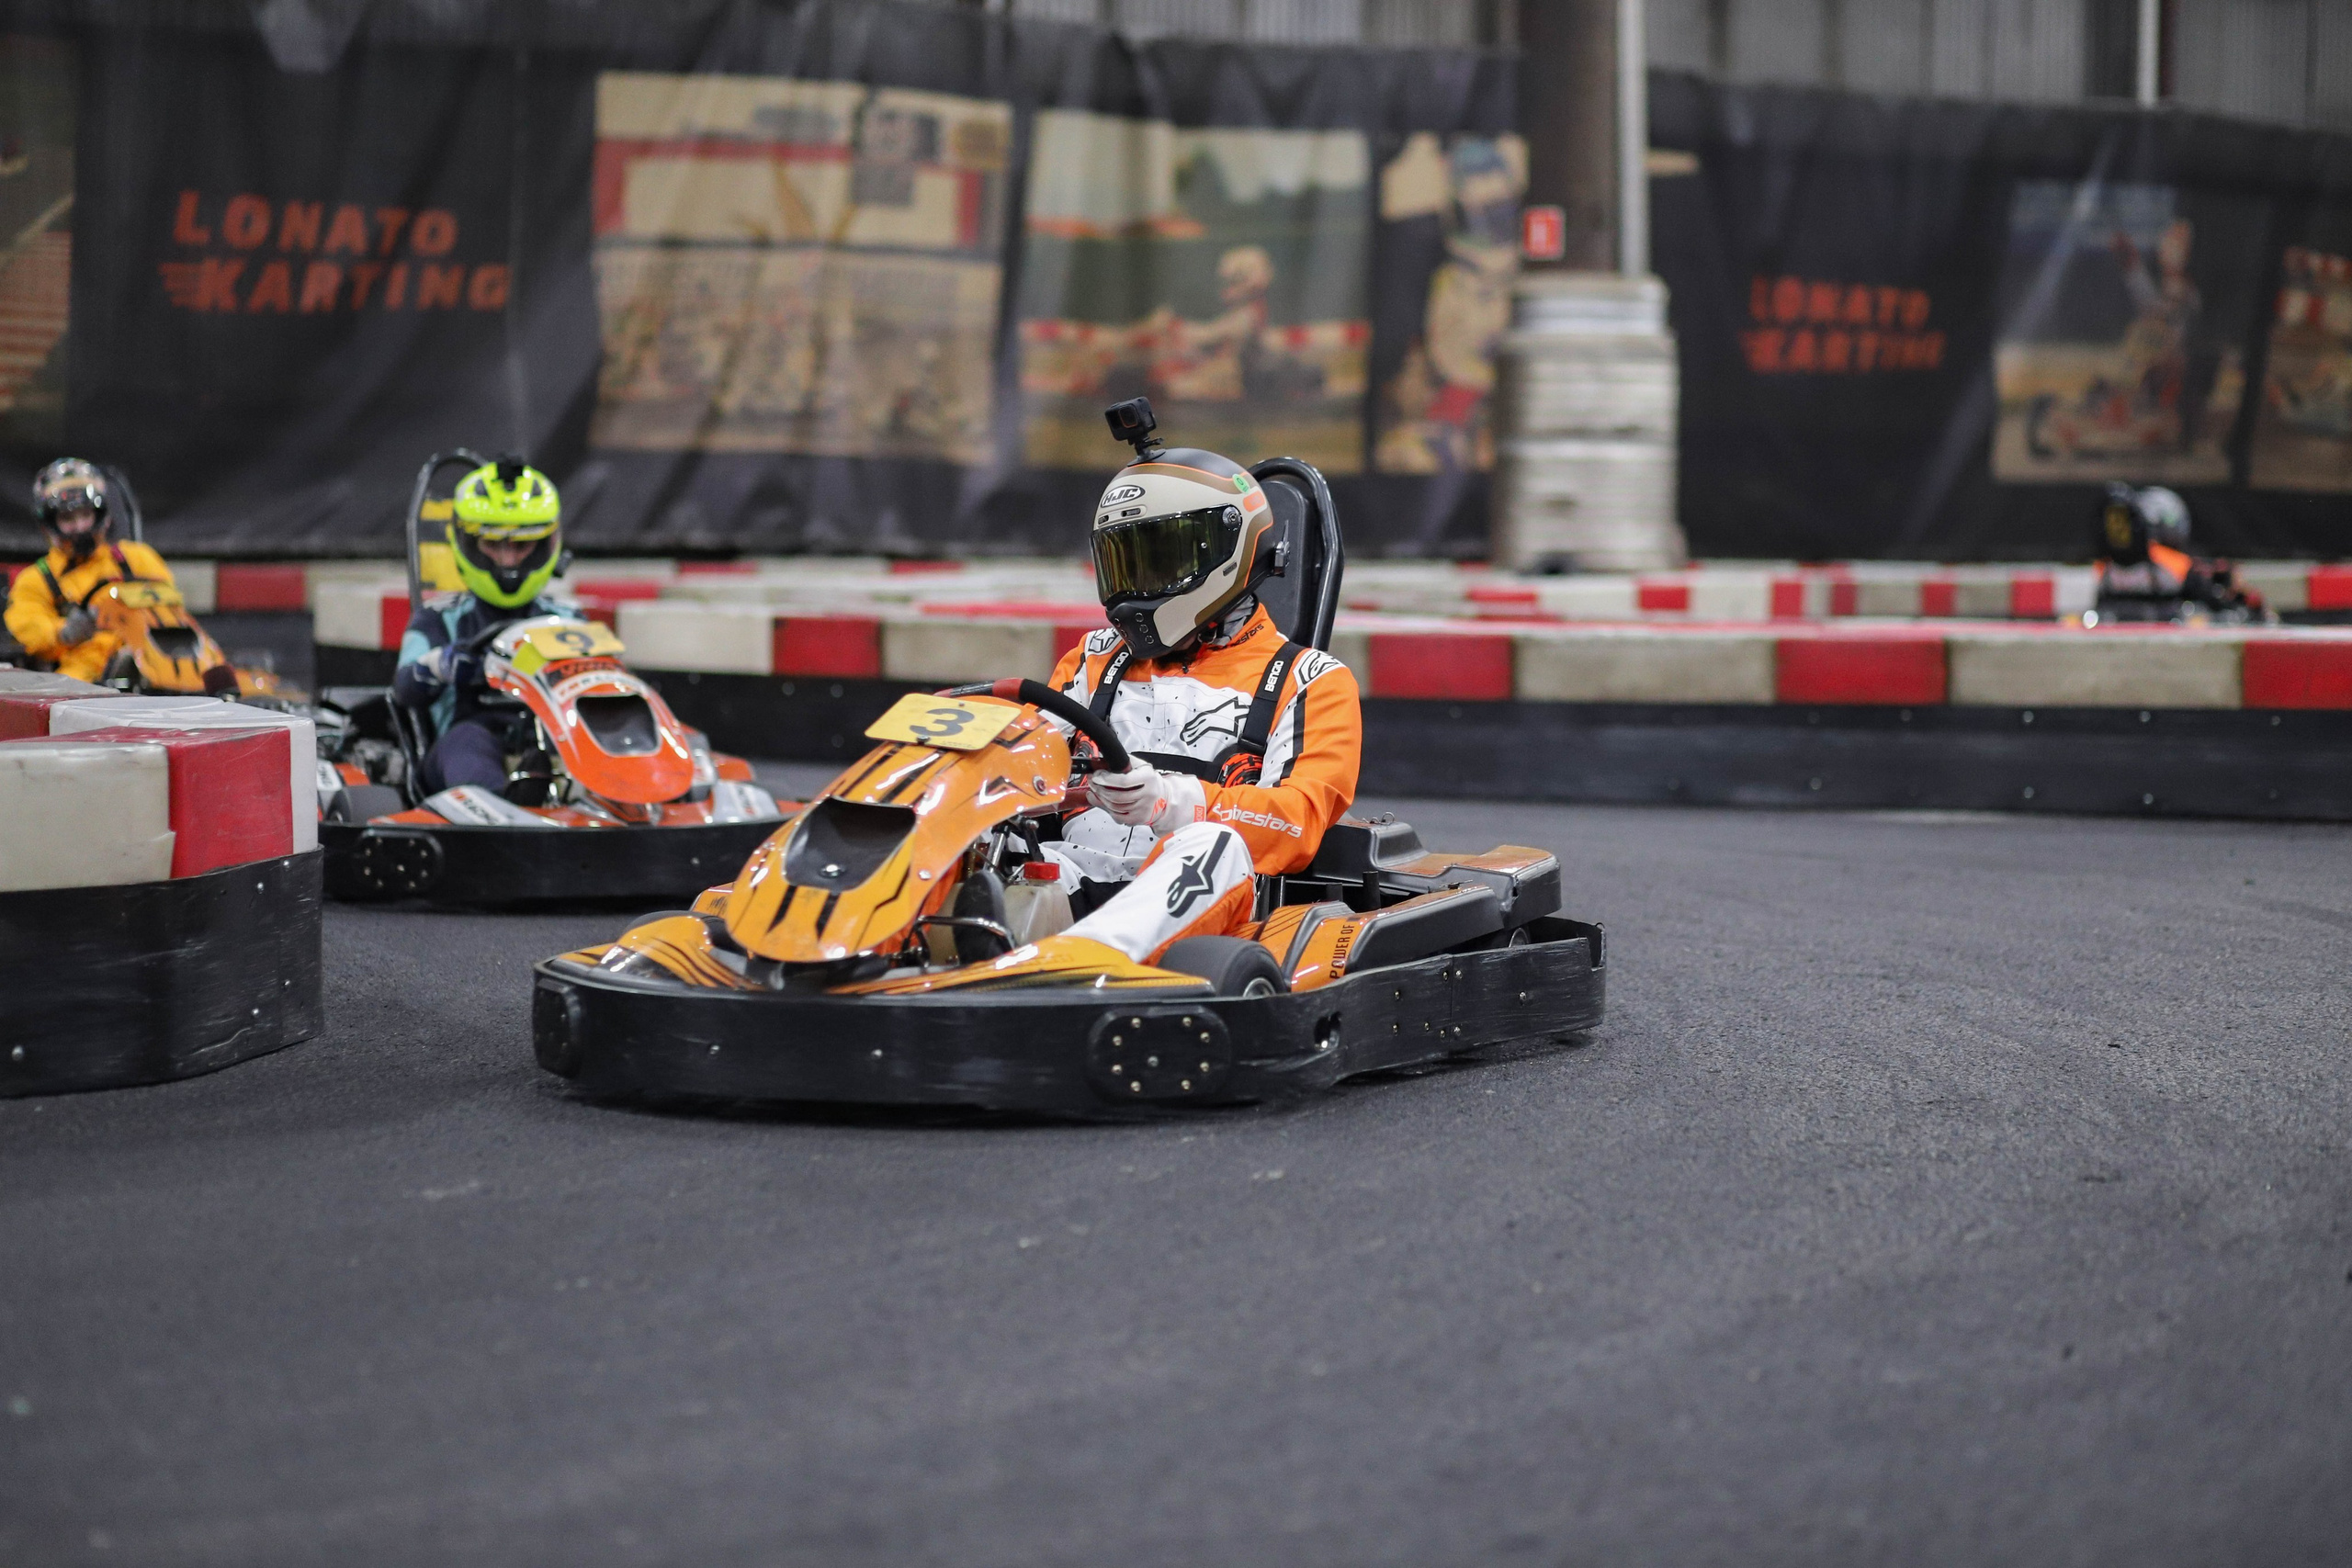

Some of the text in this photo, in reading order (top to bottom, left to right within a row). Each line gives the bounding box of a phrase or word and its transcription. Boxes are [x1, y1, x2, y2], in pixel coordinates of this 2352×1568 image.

[173, 189, 459, 257] LONATO
[180, 258, 513, 313] KARTING
[1103, 489, 1139, 506] HJC
[1103, 651, 1130, 685] BENGIO
[1264, 660, 1284, 693] BENGIO
[909, 707, 976, 738] 3
[1329, 924, 1355, 979] POWER OF
